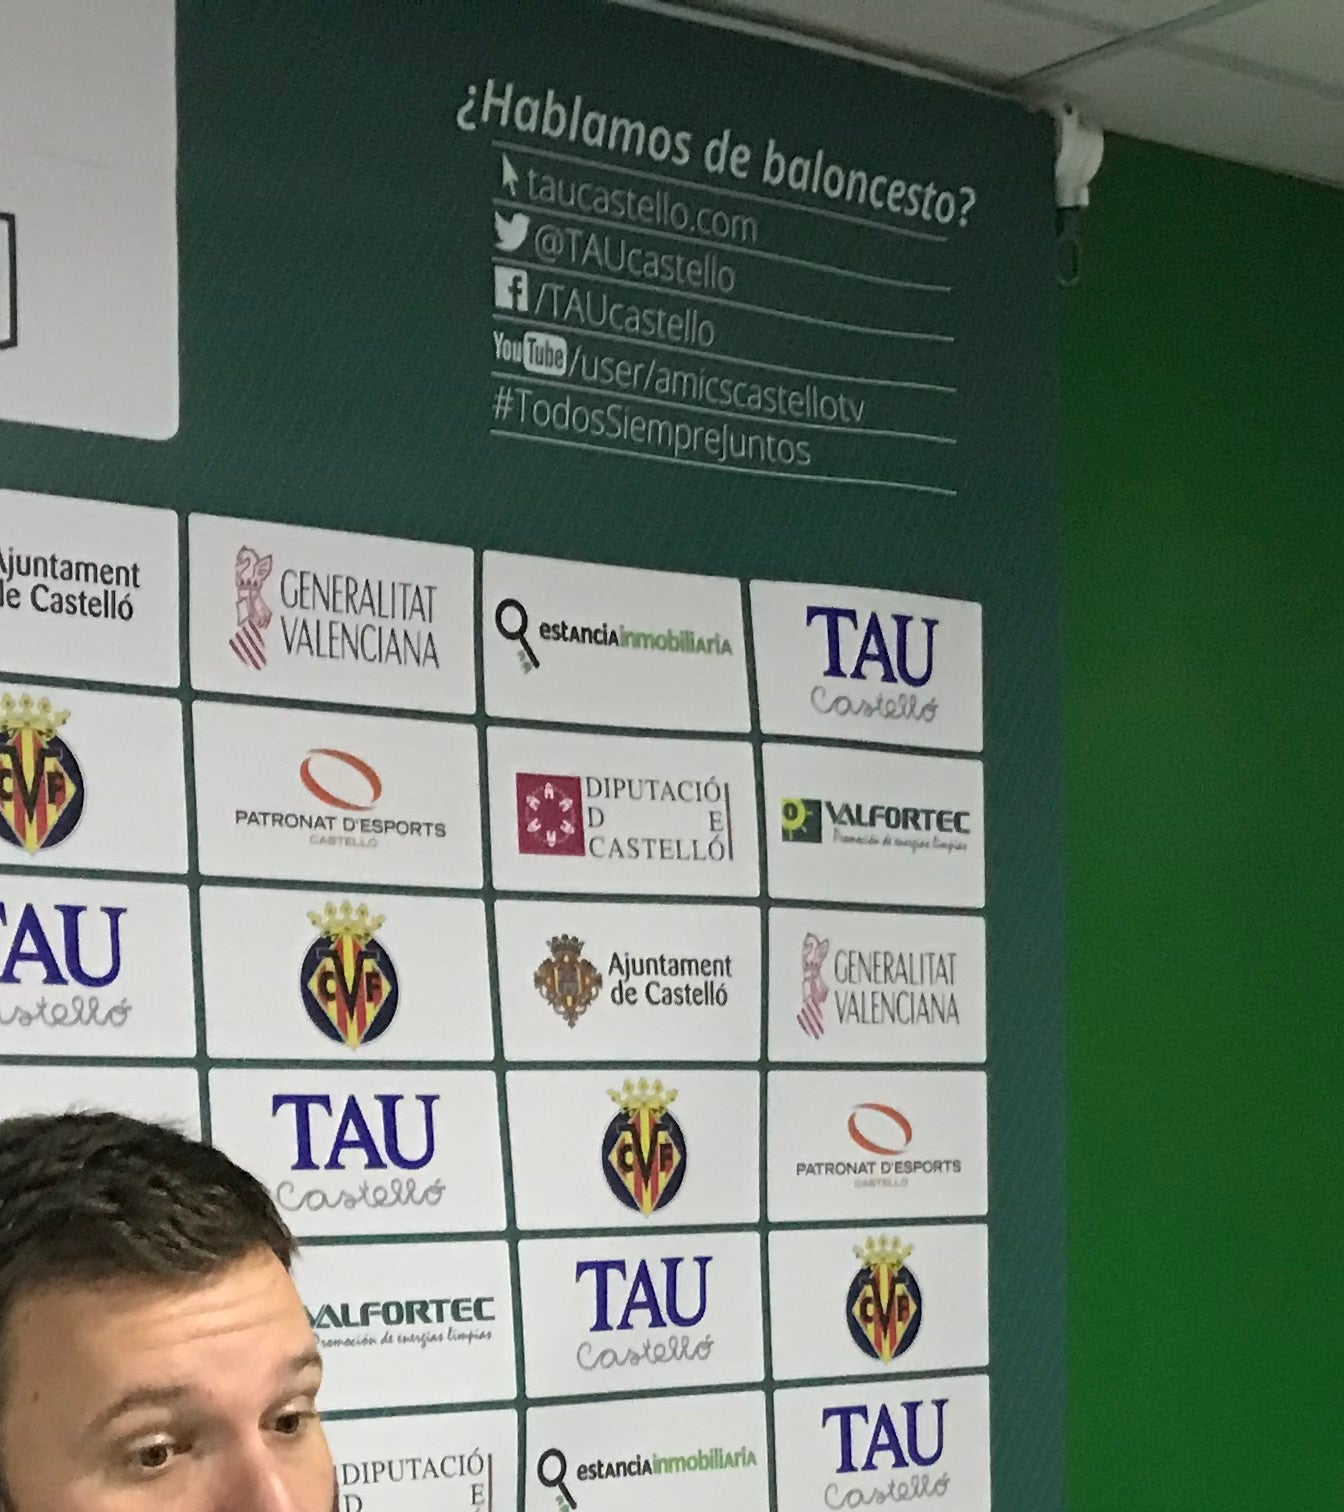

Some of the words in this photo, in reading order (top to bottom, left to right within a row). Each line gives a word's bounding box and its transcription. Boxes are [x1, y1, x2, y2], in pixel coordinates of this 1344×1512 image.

[456, 78, 693, 165] ¿Hablamos
[704, 130, 751, 179] de
[762, 139, 977, 228] baloncesto?
[528, 165, 758, 244] taucastello.com
[534, 223, 737, 293] @TAUcastello
[534, 282, 716, 348] /TAUcastello
[493, 330, 567, 374] YouTube
[568, 350, 866, 425] /user/amicscastellotv
[493, 385, 812, 467] #TodosSiempreJuntos
[30, 584, 134, 621] Castelló
[280, 568, 436, 623] GENERALITAT
[281, 616, 440, 669] VALENCIANA
[806, 606, 939, 687] TAU
[586, 775, 722, 803] DIPUTACIÓ
[235, 809, 337, 831] PATRONAT
[344, 818, 447, 838] D'ESPORTS
[825, 800, 970, 834] VALFORTEC
[588, 832, 725, 861] CASTELLÓ
[609, 951, 731, 983] Ajuntament
[835, 950, 957, 986] GENERALITAT
[611, 982, 637, 1005] de
[645, 980, 728, 1007] Castelló
[835, 990, 959, 1025] VALENCIANA
[272, 1094, 440, 1170] TAU
[796, 1161, 876, 1175] PATRONAT
[881, 1159, 961, 1174] D'ESPORTS
[576, 1256, 712, 1332] TAU
[381, 1331, 393, 1344] de
[447, 1327, 492, 1345] limpias
[822, 1400, 948, 1474] TAU
[341, 1446, 484, 1485] DIPUTACIÓ
